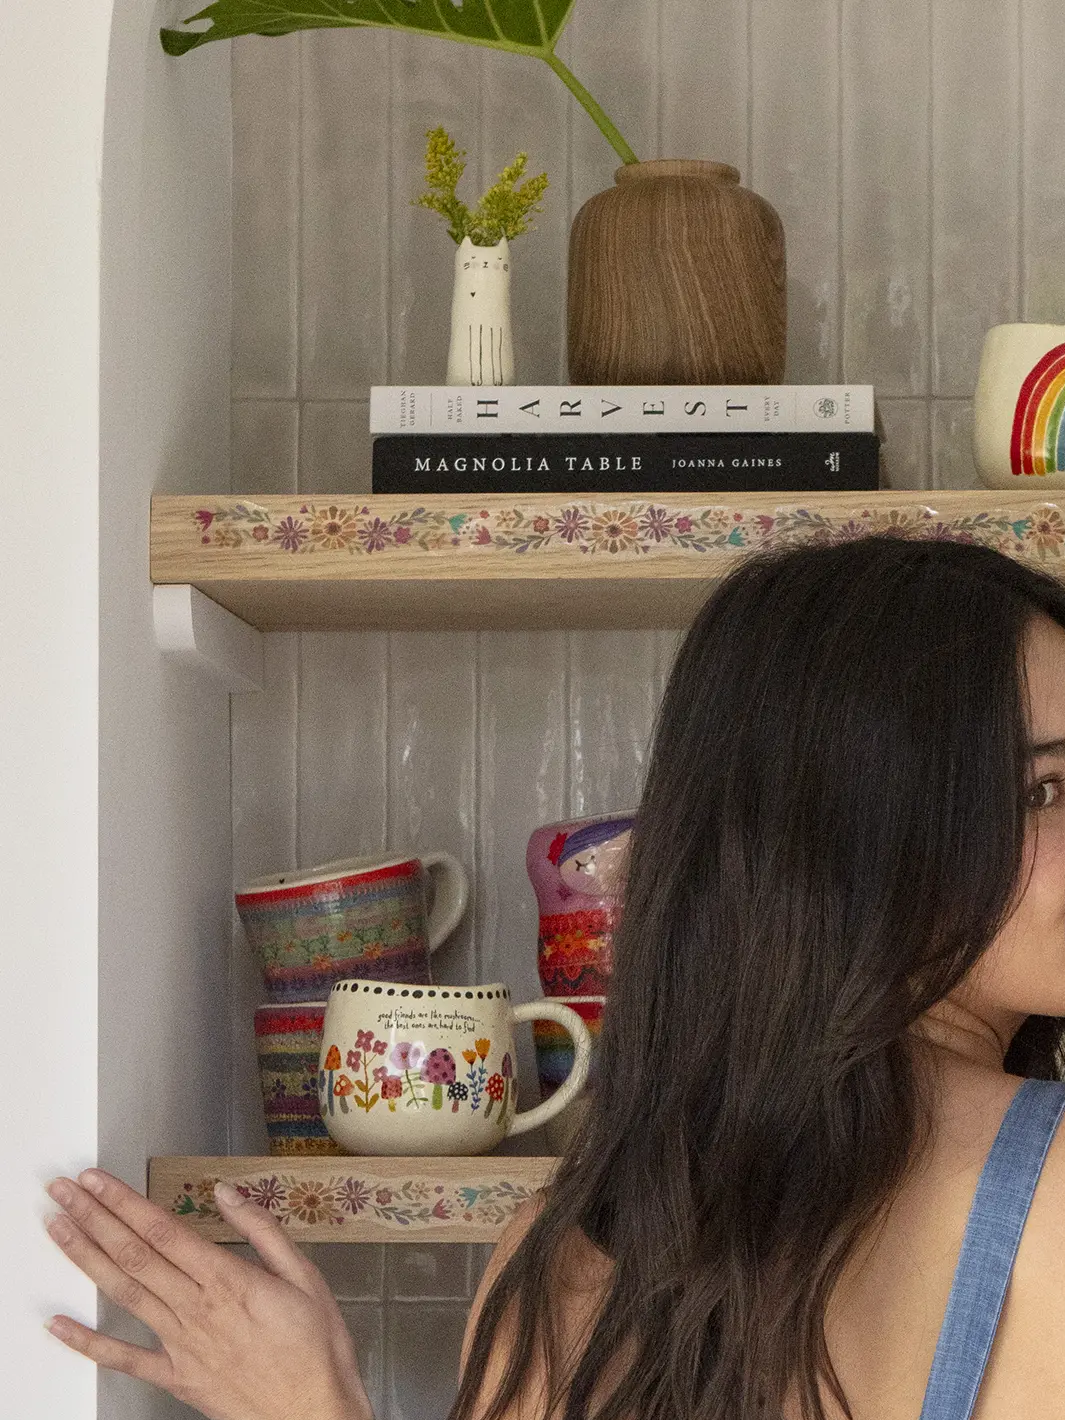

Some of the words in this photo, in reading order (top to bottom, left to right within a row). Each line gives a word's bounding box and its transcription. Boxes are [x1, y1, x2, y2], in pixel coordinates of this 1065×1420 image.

[476, 398, 748, 419] HARVEST
[414, 457, 550, 471] MAGNOLIA
[565, 457, 642, 471] TABLE
[672, 458, 725, 468] JOANNA
[731, 458, 782, 468] GAINES
[377, 1009, 393, 1023] good
[394, 1009, 416, 1021] friends
[431, 1009, 442, 1020] like
[384, 1020, 393, 1029] the
[396, 1020, 409, 1029] best
[440, 1020, 453, 1030] hard
[463, 1021, 475, 1034] find
